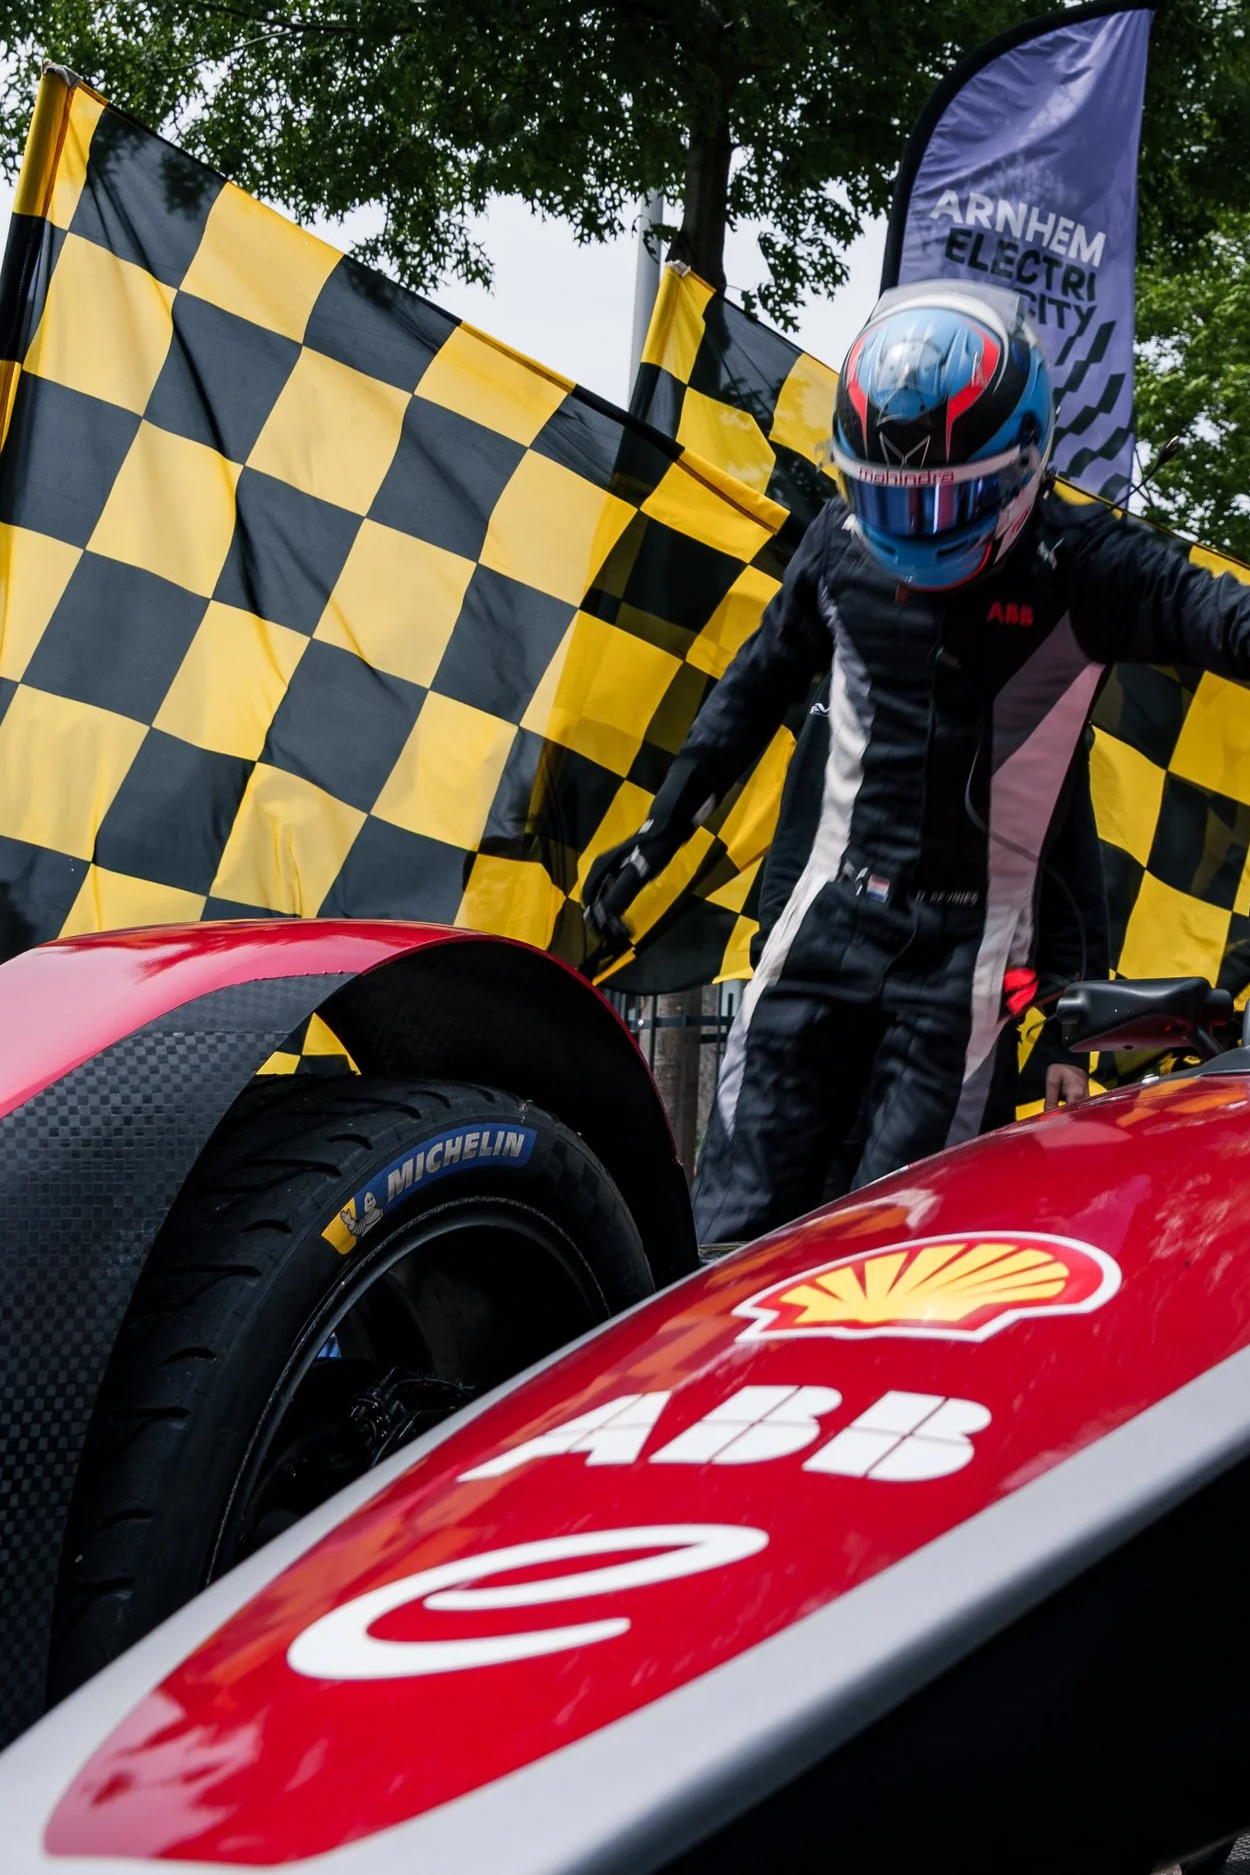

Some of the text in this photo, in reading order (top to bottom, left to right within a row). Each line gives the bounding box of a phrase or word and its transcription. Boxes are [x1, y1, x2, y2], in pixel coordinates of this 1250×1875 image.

[929, 189, 1106, 268] ARNHEM
[945, 227, 1096, 302] ELECTRI
[860, 466, 954, 485] mahindra
[986, 600, 1034, 627] ABB
[387, 1131, 525, 1202] MICHELIN
[458, 1384, 992, 1482] ABB
